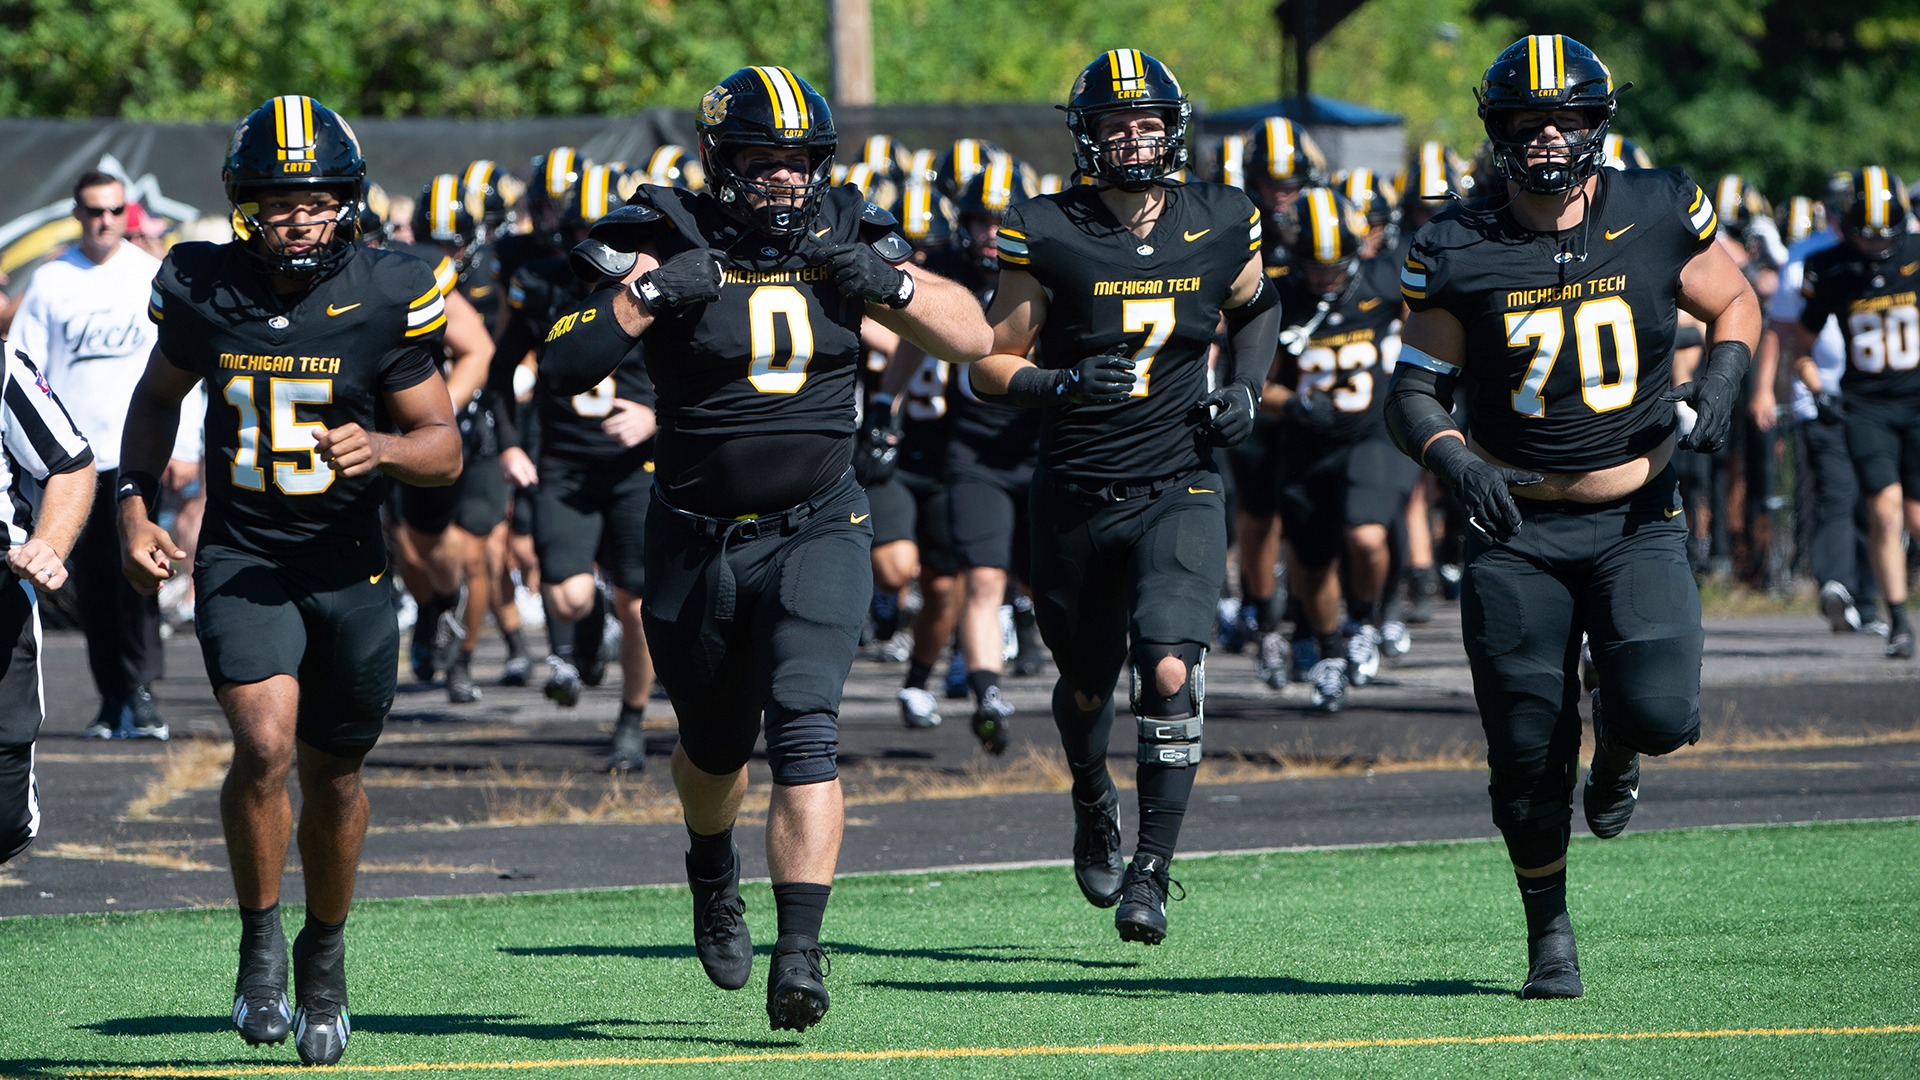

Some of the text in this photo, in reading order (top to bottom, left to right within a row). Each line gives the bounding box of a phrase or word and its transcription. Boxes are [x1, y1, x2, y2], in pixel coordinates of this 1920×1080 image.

[1093, 276, 1201, 296] MICHIGAN TECH
[1507, 274, 1627, 308] MICHIGAN TECH
[62, 309, 147, 371] Tech
[219, 353, 341, 374] MICHIGAN TECH
[747, 285, 815, 394] 0
[1122, 297, 1176, 397] 7
[1503, 295, 1639, 419] 70
[1847, 304, 1920, 374] 80
[223, 375, 336, 495] 15
